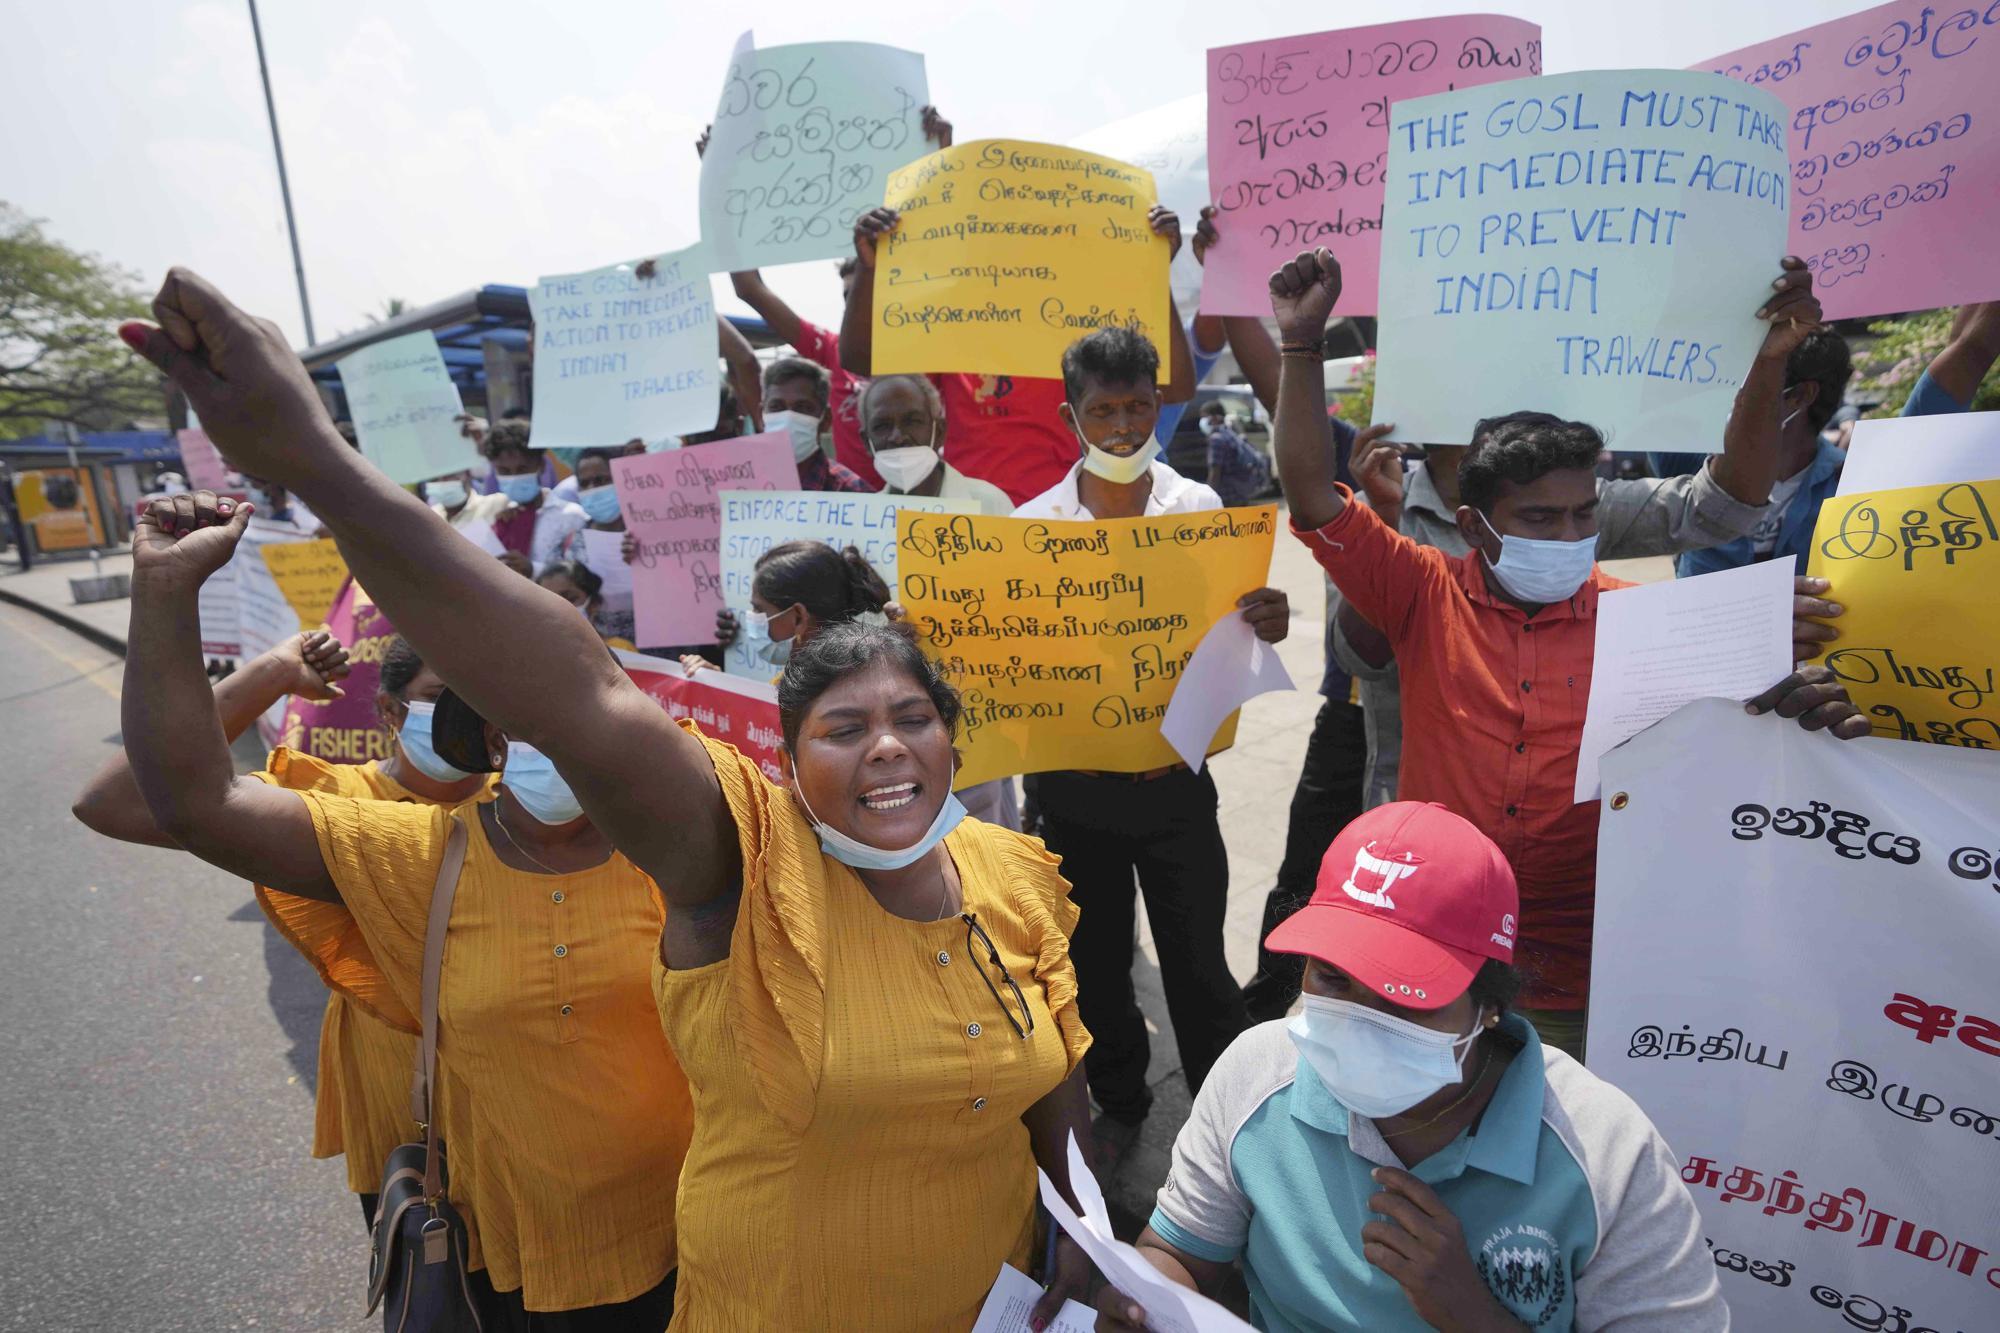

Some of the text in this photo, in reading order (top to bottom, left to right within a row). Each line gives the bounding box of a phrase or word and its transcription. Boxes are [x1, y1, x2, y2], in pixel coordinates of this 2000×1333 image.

[1397, 91, 1784, 152] THE GOSL MUST TAKE
[1408, 148, 1784, 210] IMMEDIATE ACTION
[1410, 208, 1686, 257] TO PREVENT
[541, 279, 585, 298] THE
[541, 282, 696, 323] TAKE IMMEDIATE
[542, 301, 711, 349] ACTION TO PREVENT
[560, 353, 627, 378] INDIAN
[728, 500, 914, 529] ENFORCE THE LA
[902, 515, 1003, 565] இந்திய
[905, 573, 985, 614] எமது
[1825, 648, 1994, 709] எமது
[1628, 1024, 1789, 1071] இந்திய
[1482, 1227, 1513, 1256] PRAJA
